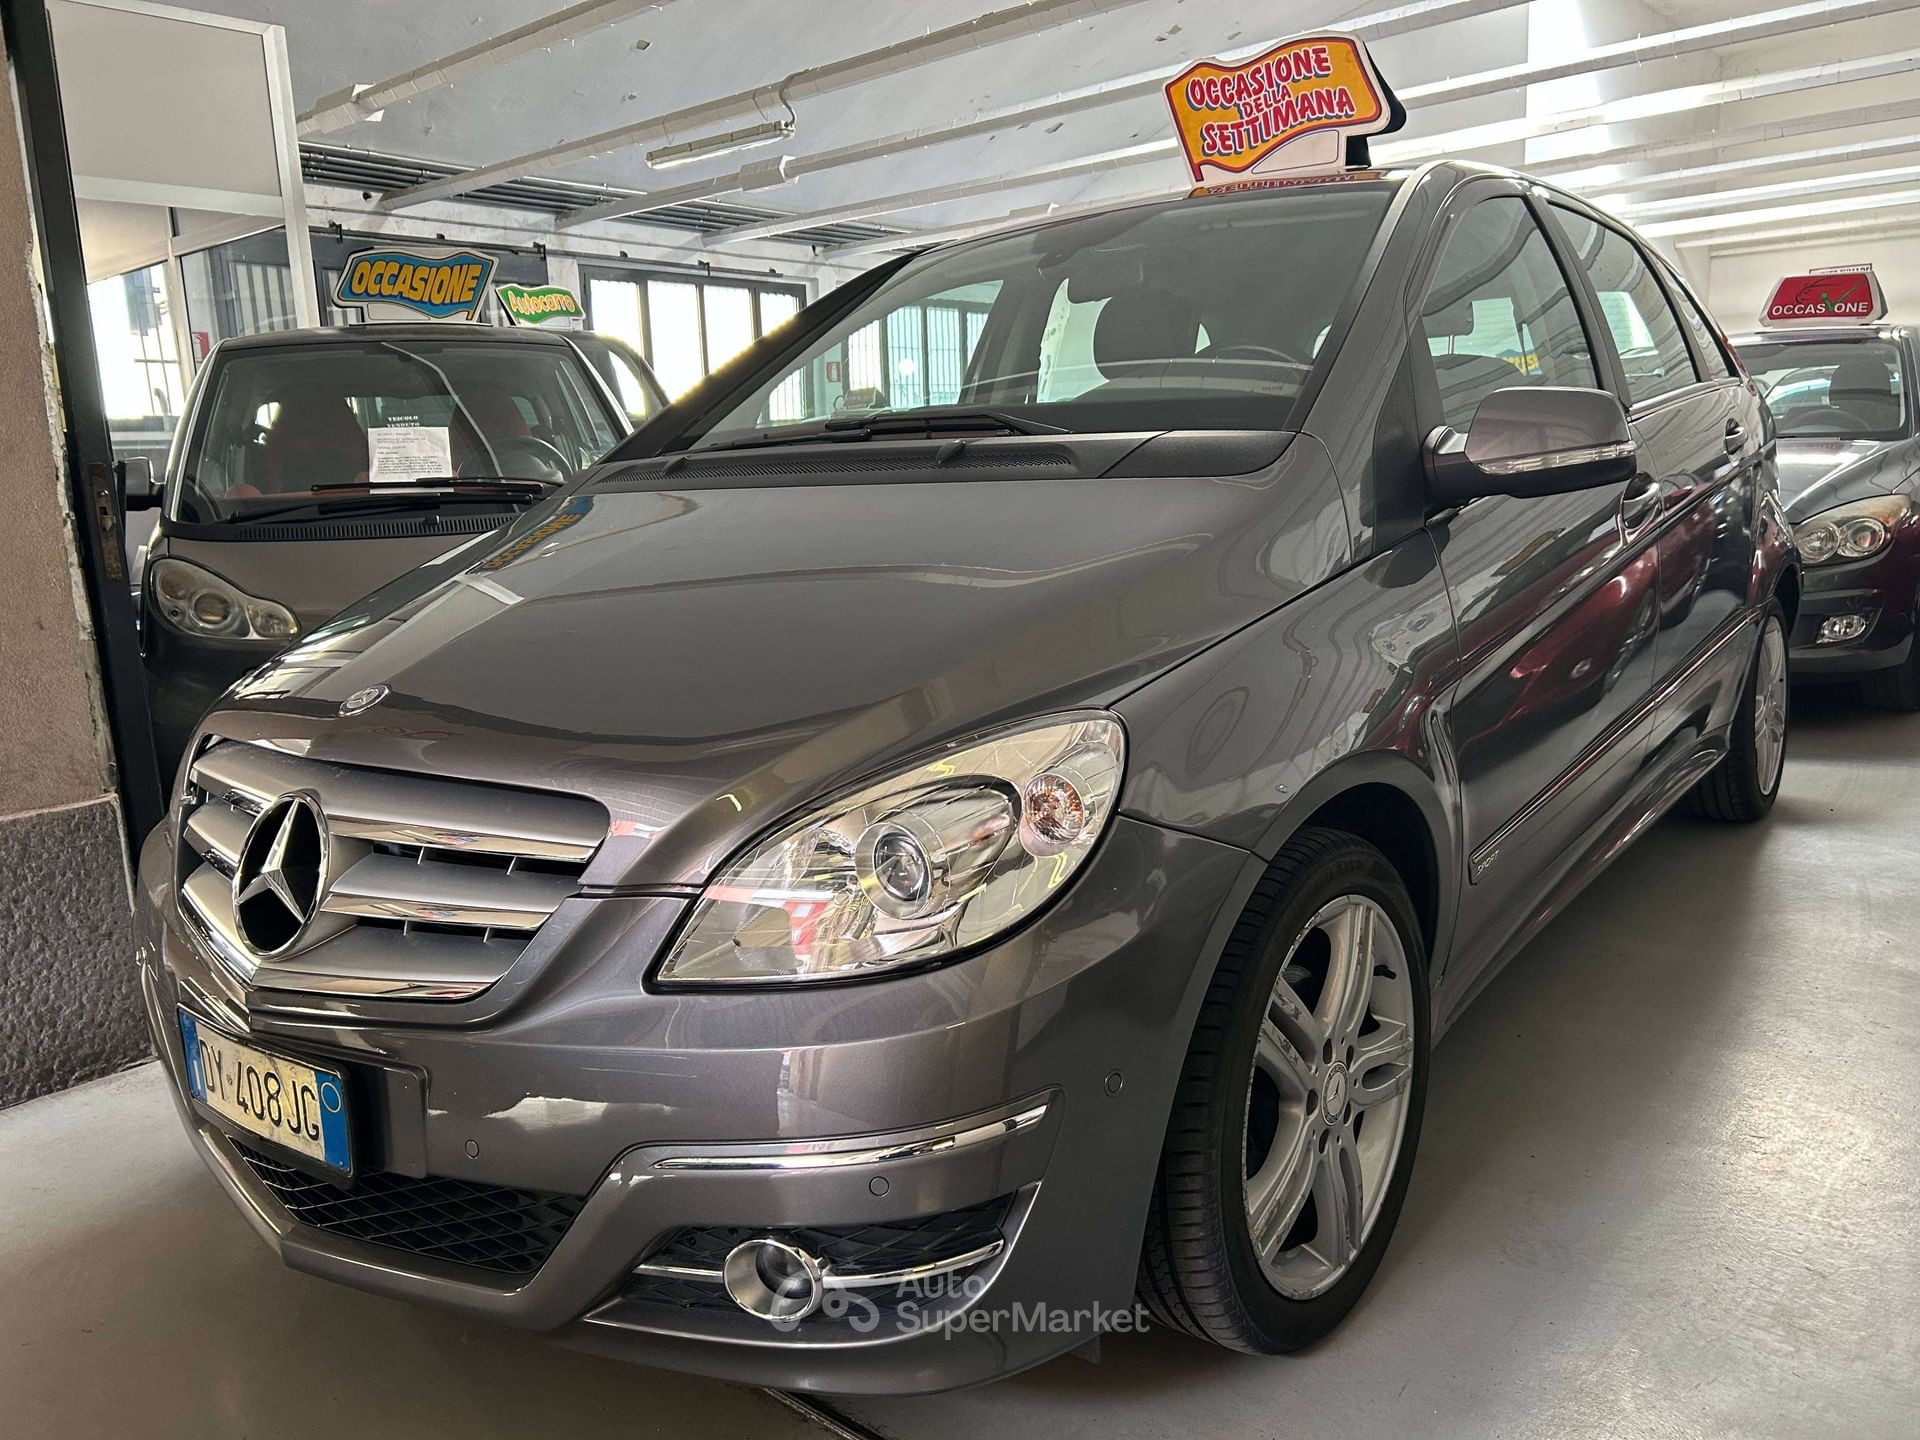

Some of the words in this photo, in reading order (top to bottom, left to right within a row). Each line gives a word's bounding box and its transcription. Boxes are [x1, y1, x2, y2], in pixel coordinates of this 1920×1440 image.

[1189, 47, 1332, 107] OCCASIONE
[1243, 85, 1292, 118] DELLA
[1203, 87, 1356, 153] SETTIMANA
[351, 260, 483, 304] OCCASIONE
[510, 290, 576, 316] Autocarro
[199, 1038, 226, 1100] DY
